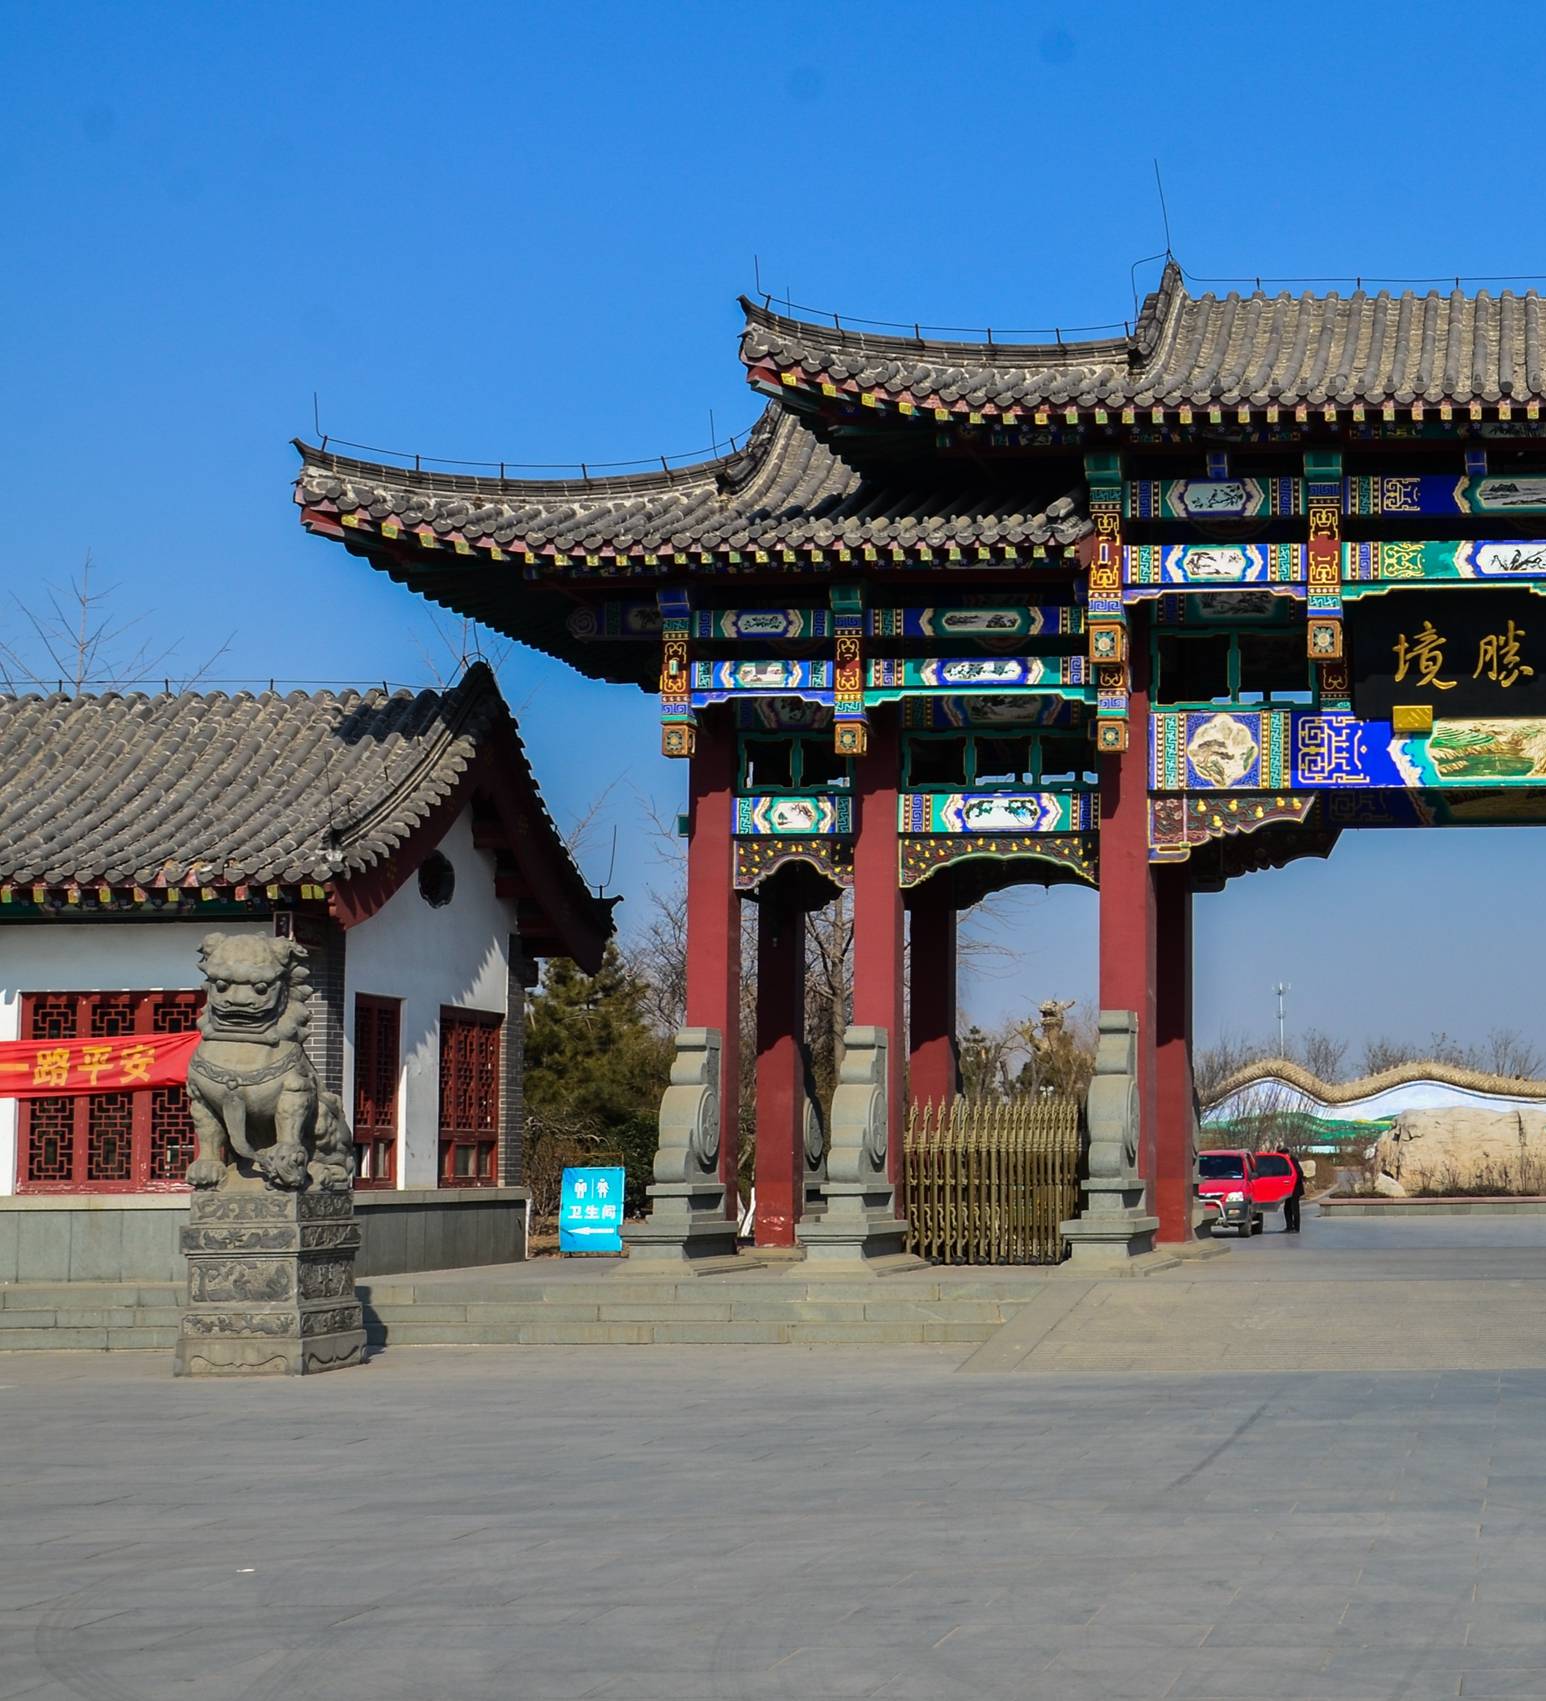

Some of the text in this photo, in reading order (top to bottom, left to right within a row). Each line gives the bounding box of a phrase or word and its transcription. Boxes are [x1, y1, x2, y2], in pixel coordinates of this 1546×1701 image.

[0, 1044, 156, 1086] 一路平安
[568, 1205, 616, 1219] 卫生间
